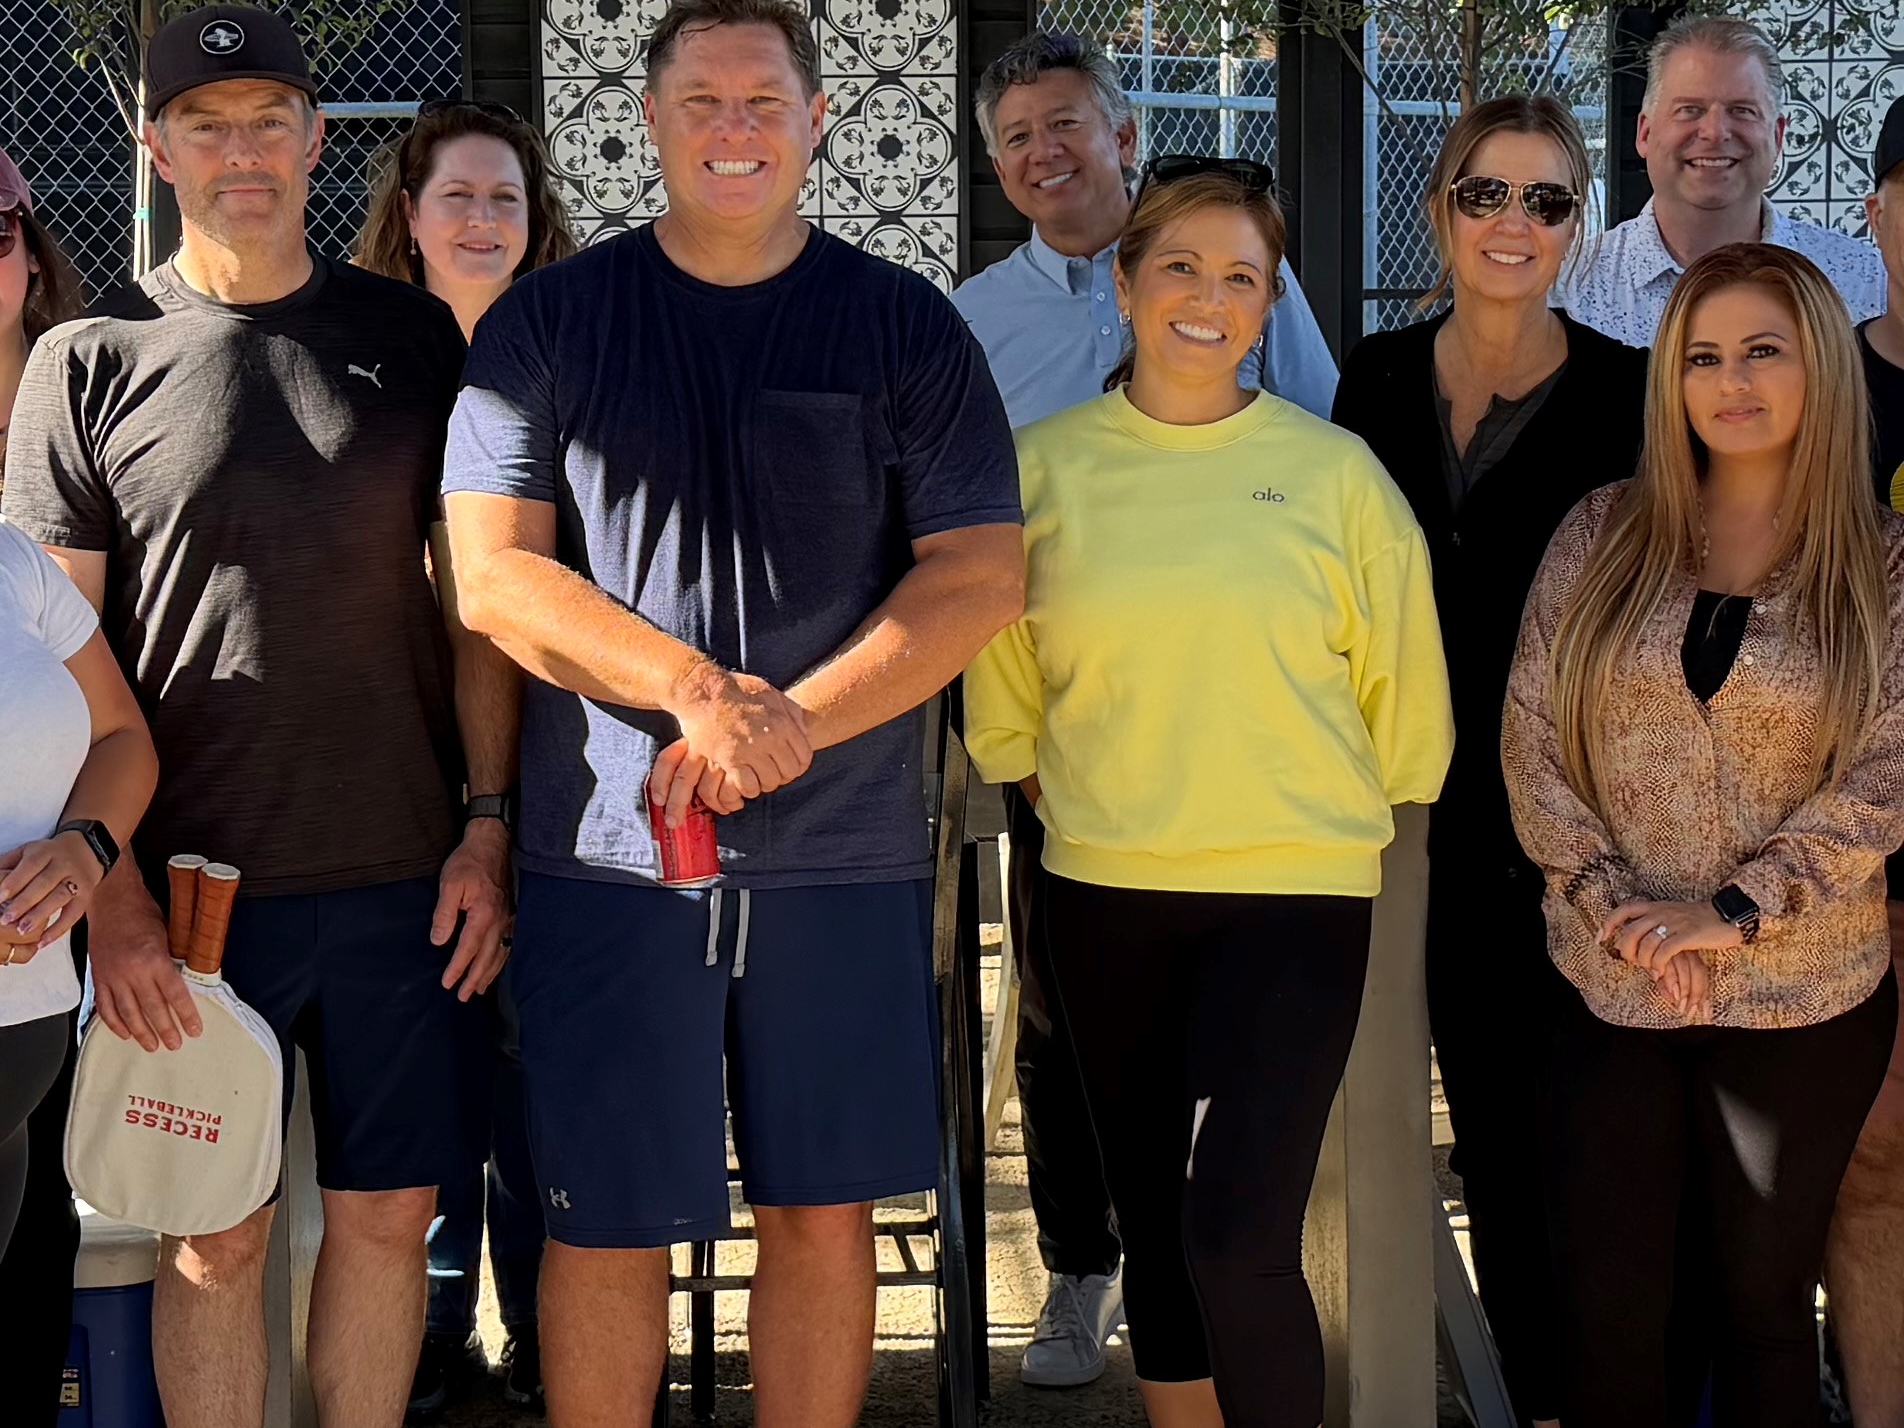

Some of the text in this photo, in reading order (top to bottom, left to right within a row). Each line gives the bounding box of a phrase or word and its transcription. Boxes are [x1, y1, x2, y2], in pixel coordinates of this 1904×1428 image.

[1252, 487, 1285, 503] alo
[124, 1108, 220, 1144] RECESS
[127, 1094, 223, 1126] PICKLEBALL
